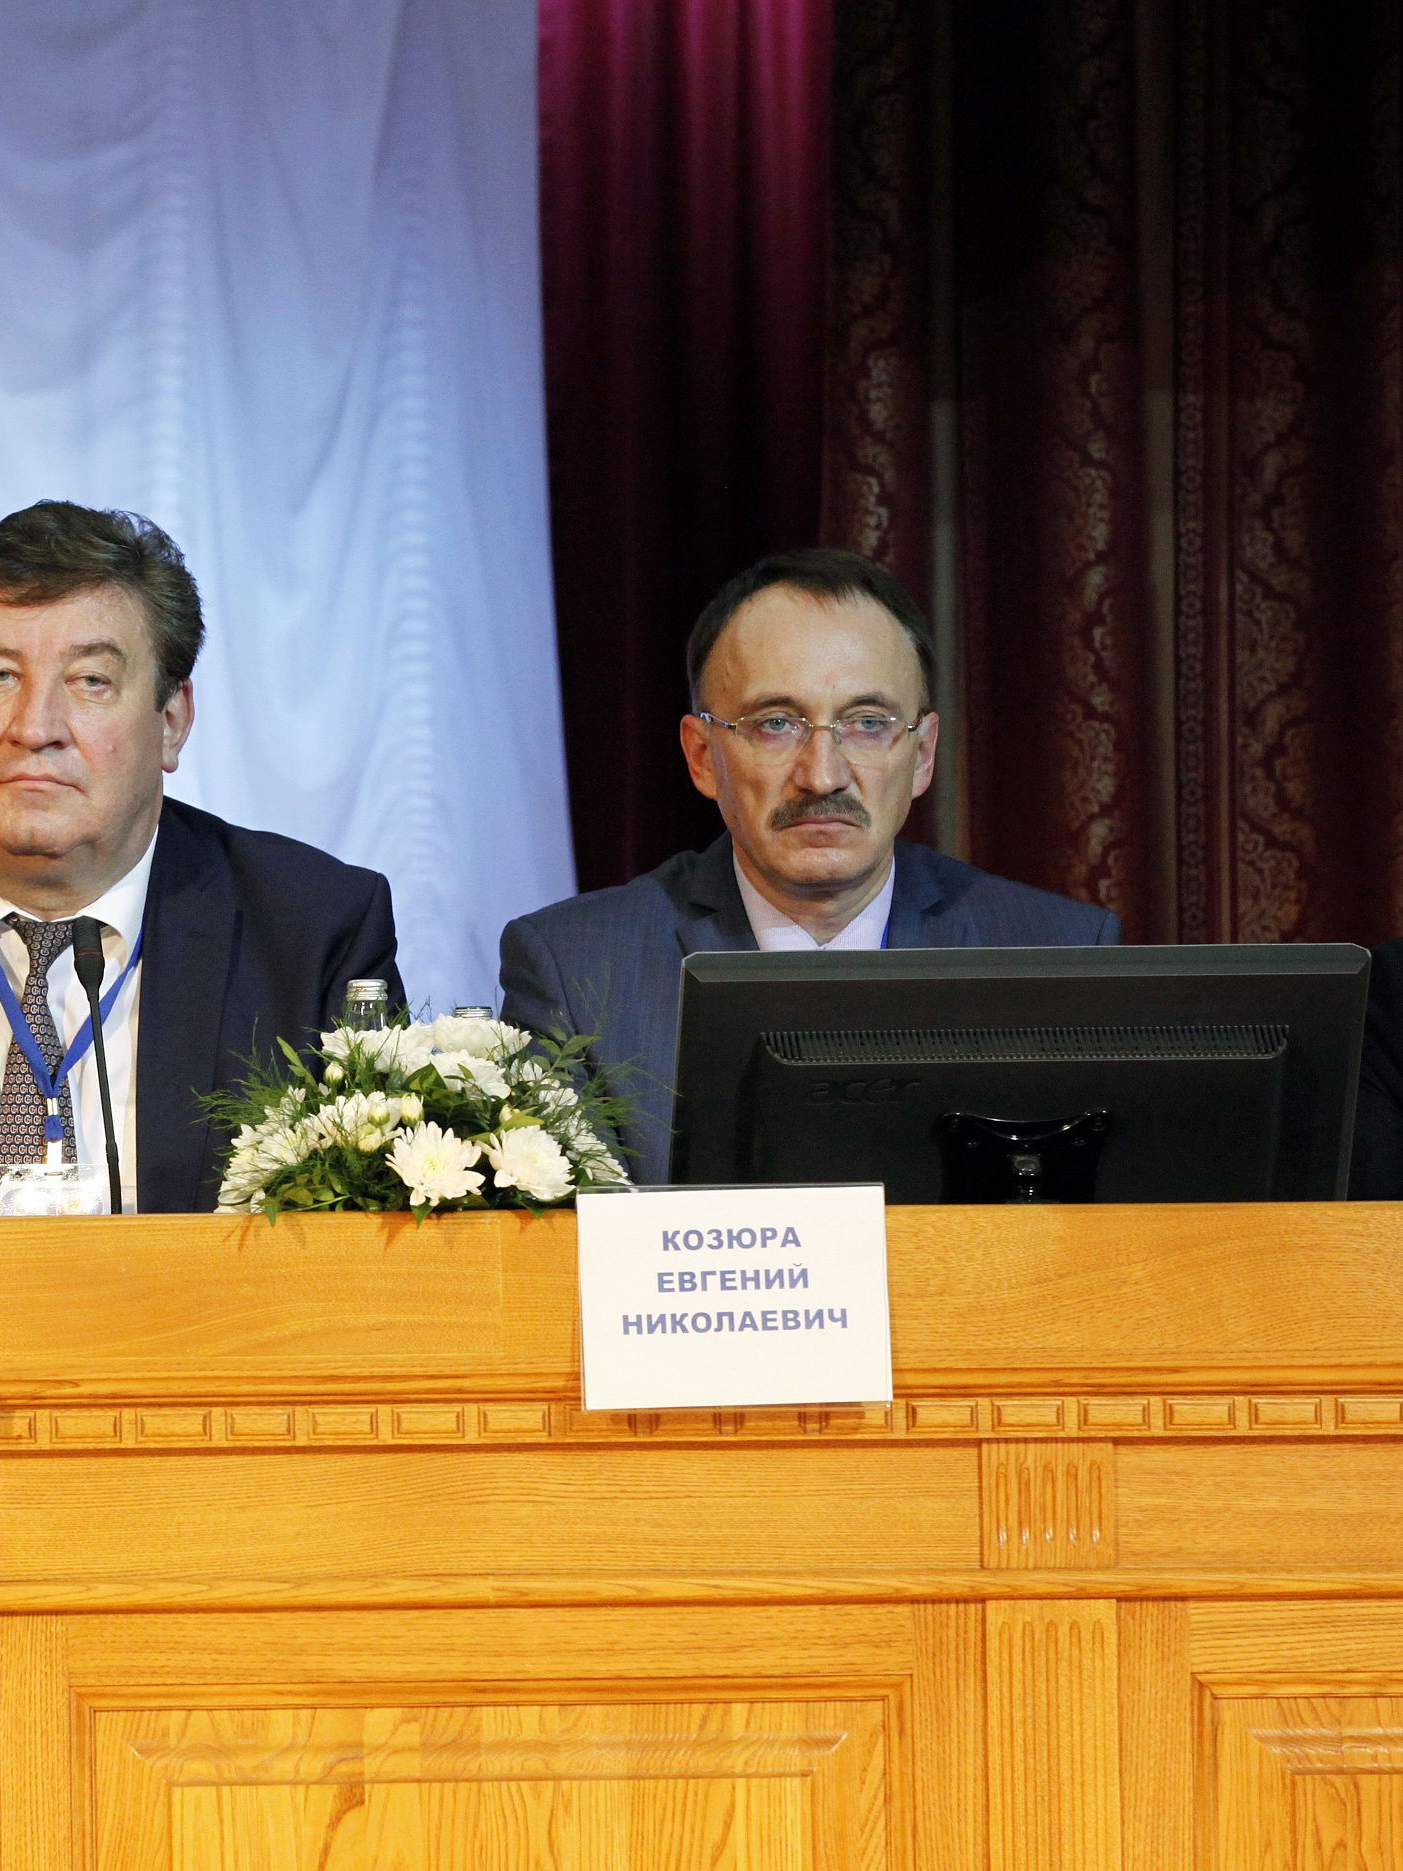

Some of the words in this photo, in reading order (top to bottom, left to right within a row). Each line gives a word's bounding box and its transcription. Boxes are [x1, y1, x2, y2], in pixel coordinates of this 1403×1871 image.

[661, 1226, 802, 1252] КОЗЮРА
[656, 1264, 810, 1294] ЕВГЕНИЙ
[621, 1308, 849, 1336] НИКОЛАЕВИЧ
